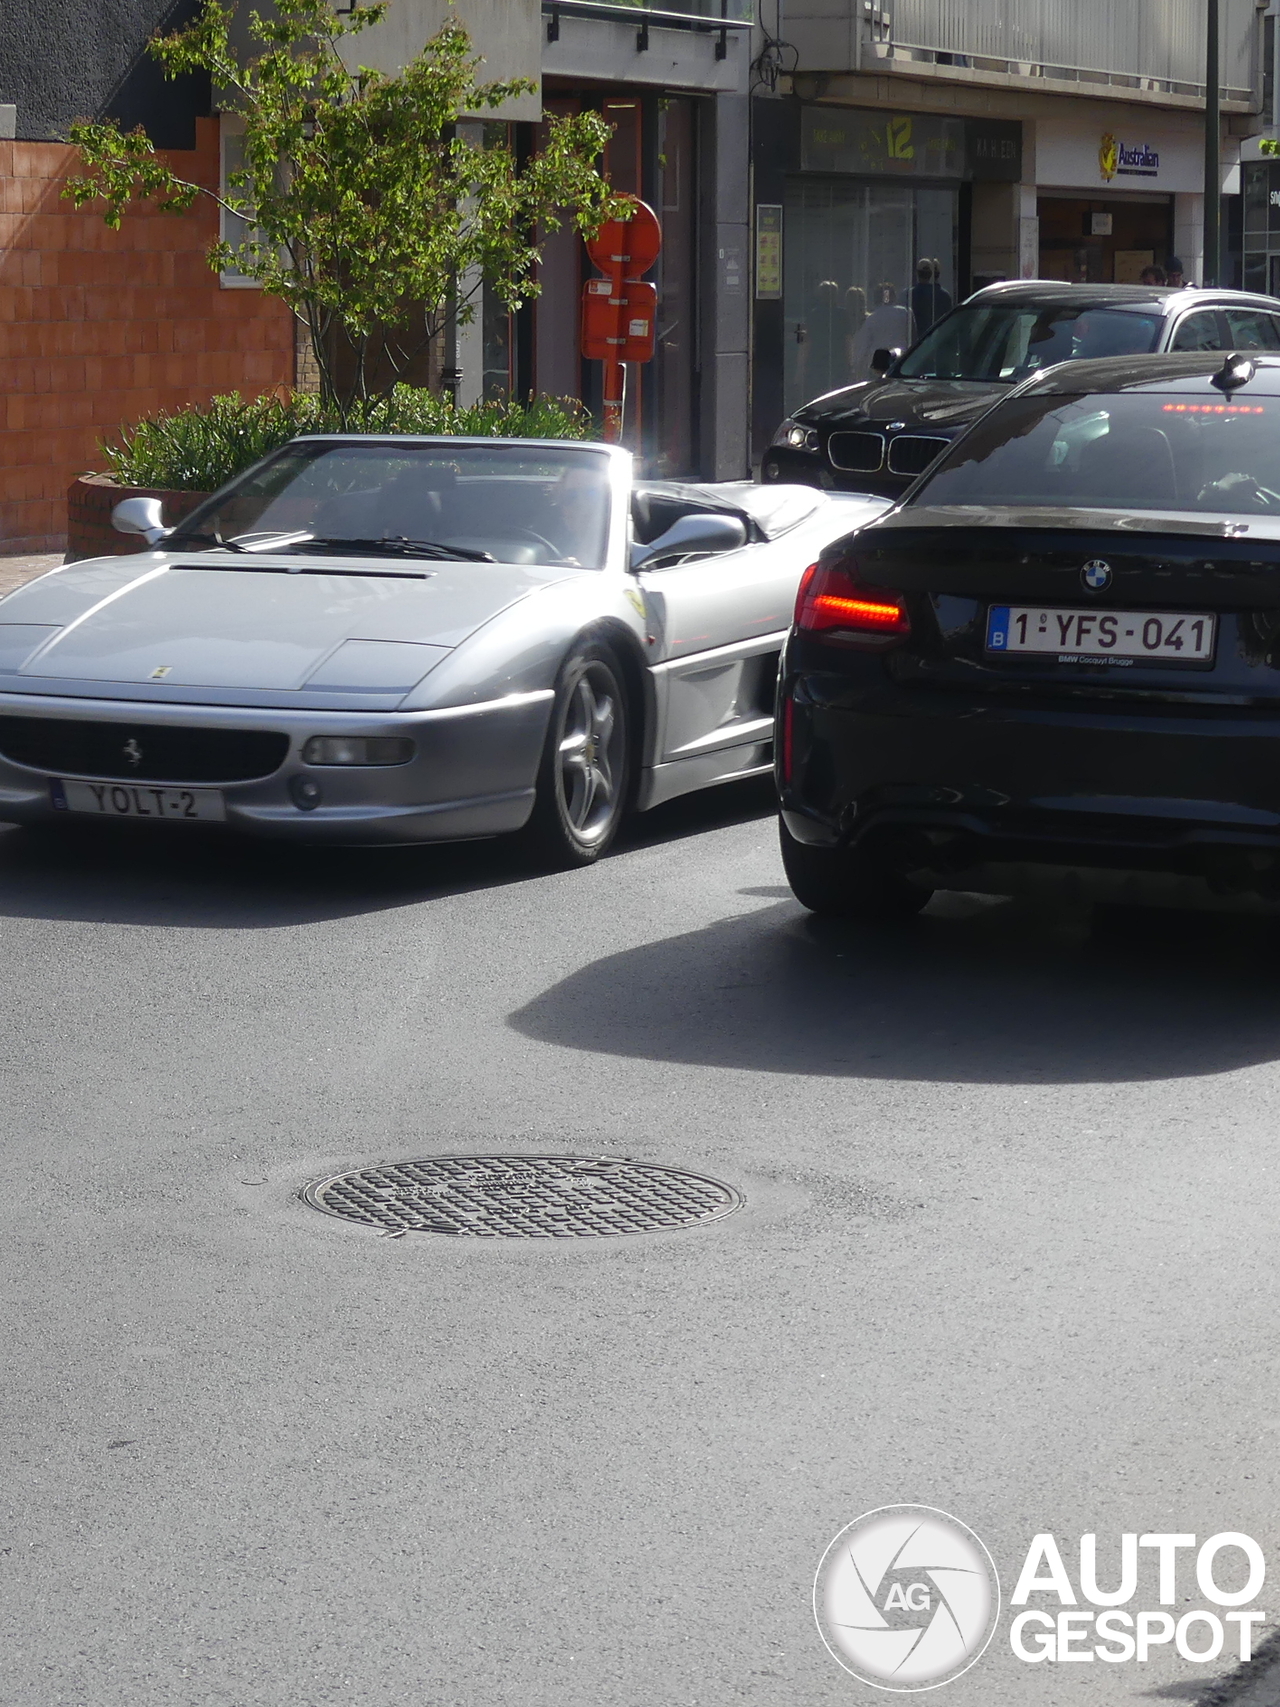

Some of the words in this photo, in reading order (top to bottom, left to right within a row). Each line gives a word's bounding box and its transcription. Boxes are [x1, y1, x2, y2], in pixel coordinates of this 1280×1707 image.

[1118, 143, 1159, 168] Australian
[993, 631, 1004, 647] B
[1058, 655, 1079, 663] BMW
[1108, 657, 1134, 667] Brugge
[88, 784, 198, 818] YOLT-2
